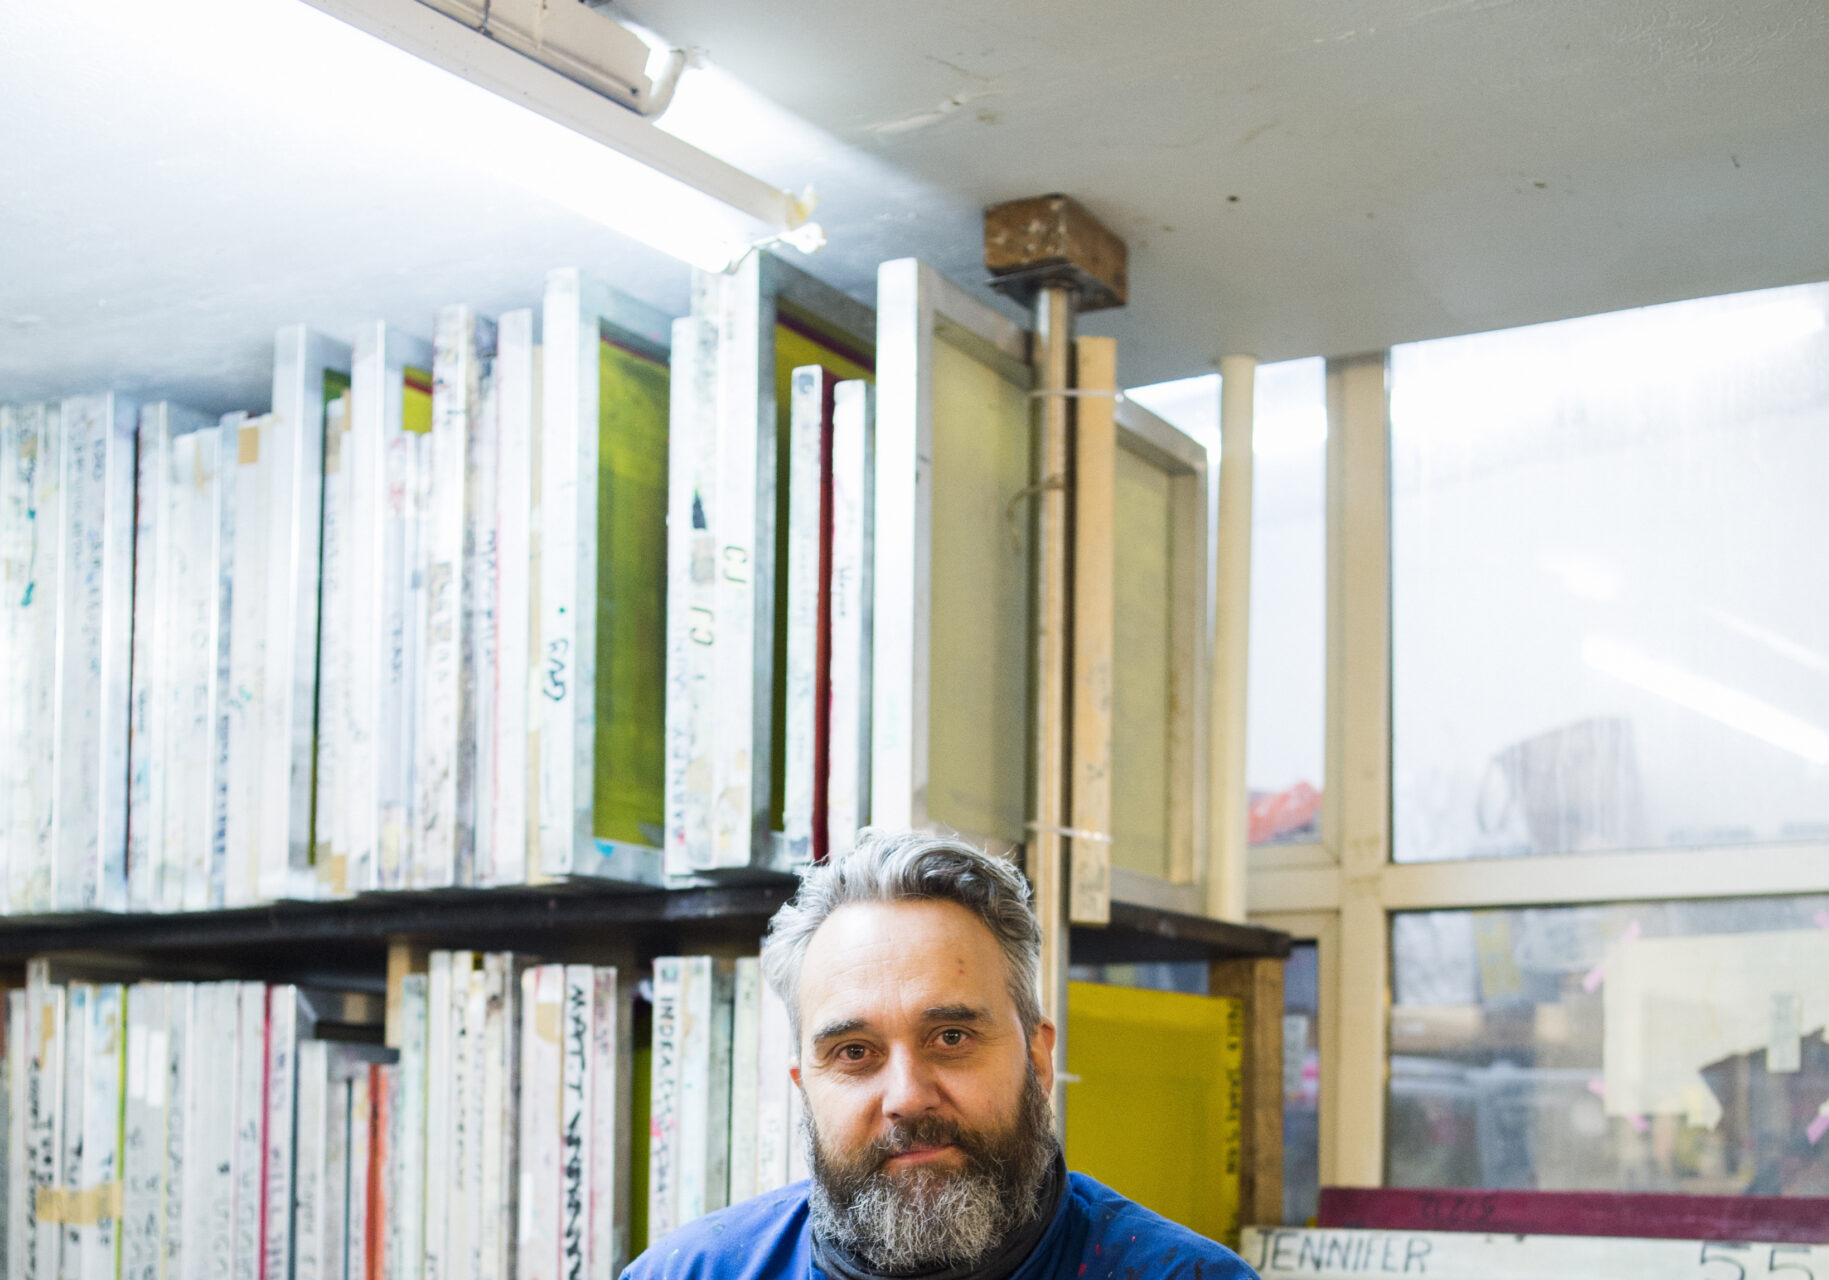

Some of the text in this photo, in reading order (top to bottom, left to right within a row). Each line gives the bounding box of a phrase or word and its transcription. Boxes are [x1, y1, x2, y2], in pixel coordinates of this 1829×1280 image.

[723, 543, 747, 586] CJ
[690, 604, 715, 648] CJ
[1254, 1228, 1432, 1274] JENNIFER
